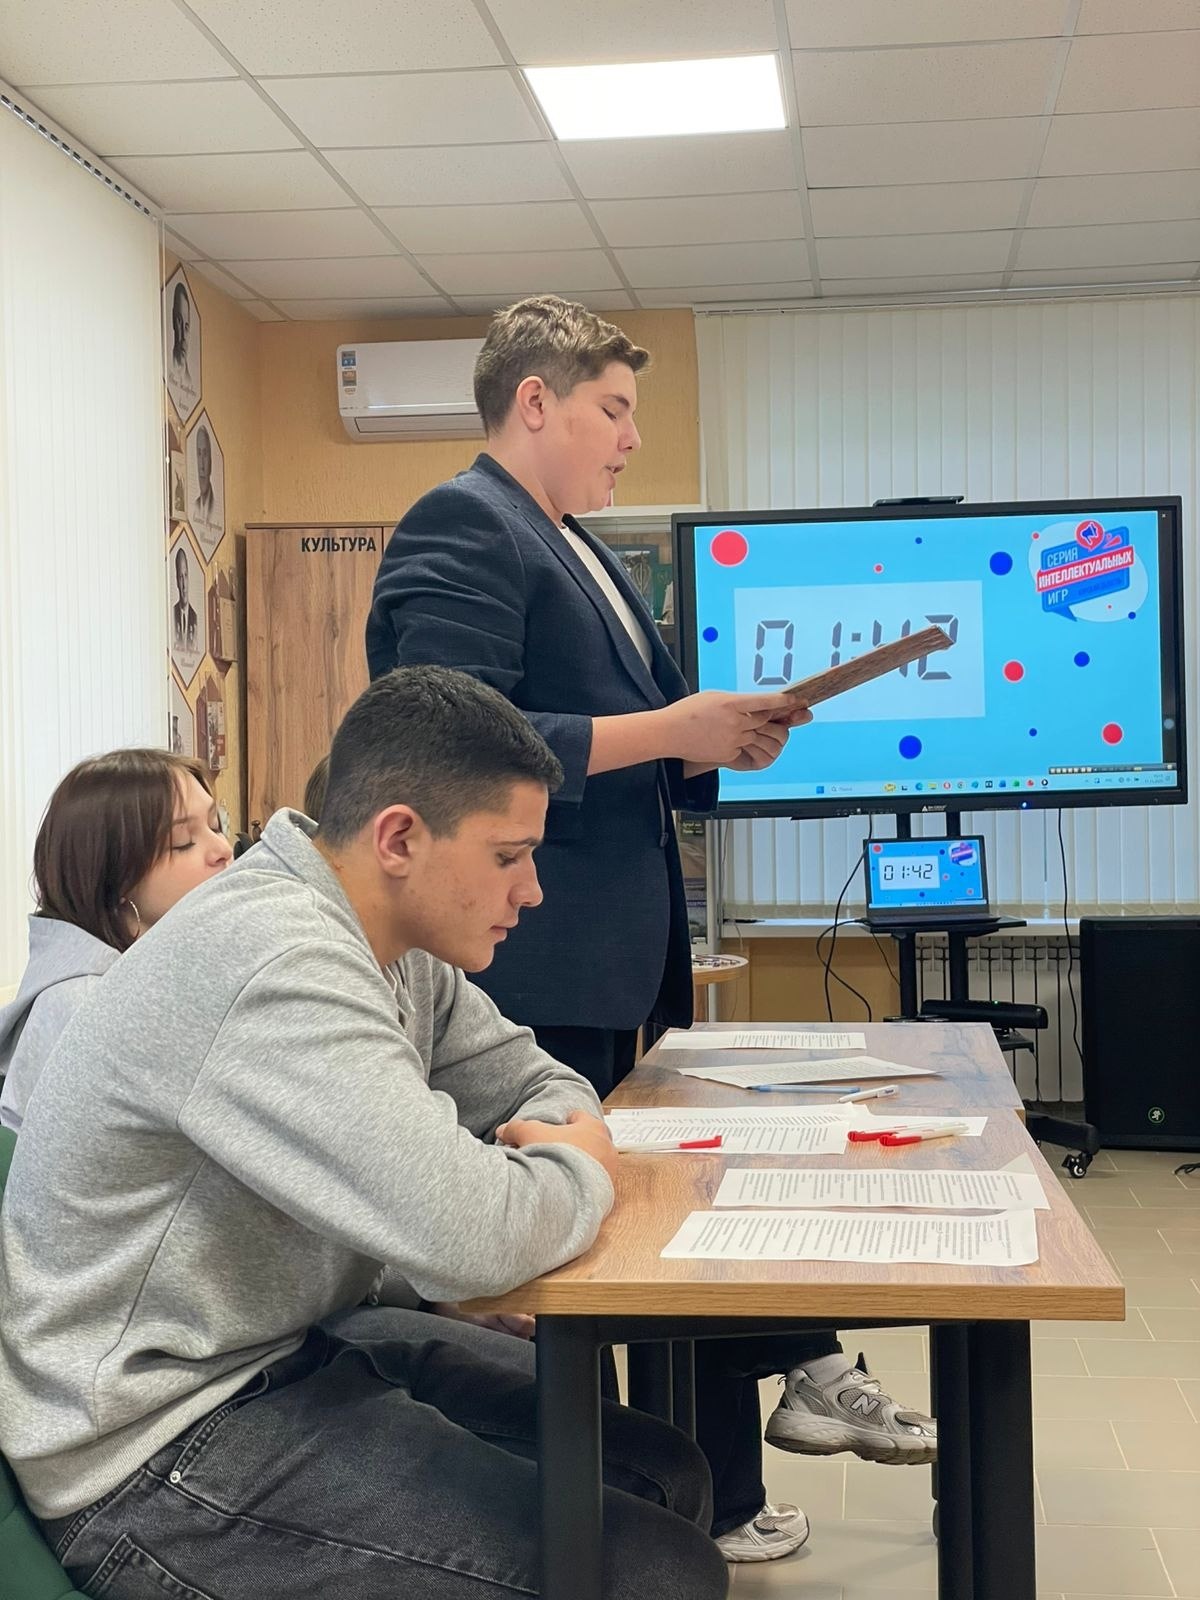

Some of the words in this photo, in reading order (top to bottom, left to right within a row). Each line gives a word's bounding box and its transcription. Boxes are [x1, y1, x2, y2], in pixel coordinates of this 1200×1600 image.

[301, 536, 377, 553] КУЛЬТУРА
[1047, 547, 1078, 567] СЕРИЯ
[1038, 550, 1132, 588] ИНТЕЛЛЕКТУАЛЬНЫХ
[1048, 589, 1069, 606] ИГР
[883, 863, 933, 881] 01:42
[850, 1393, 880, 1416] N
